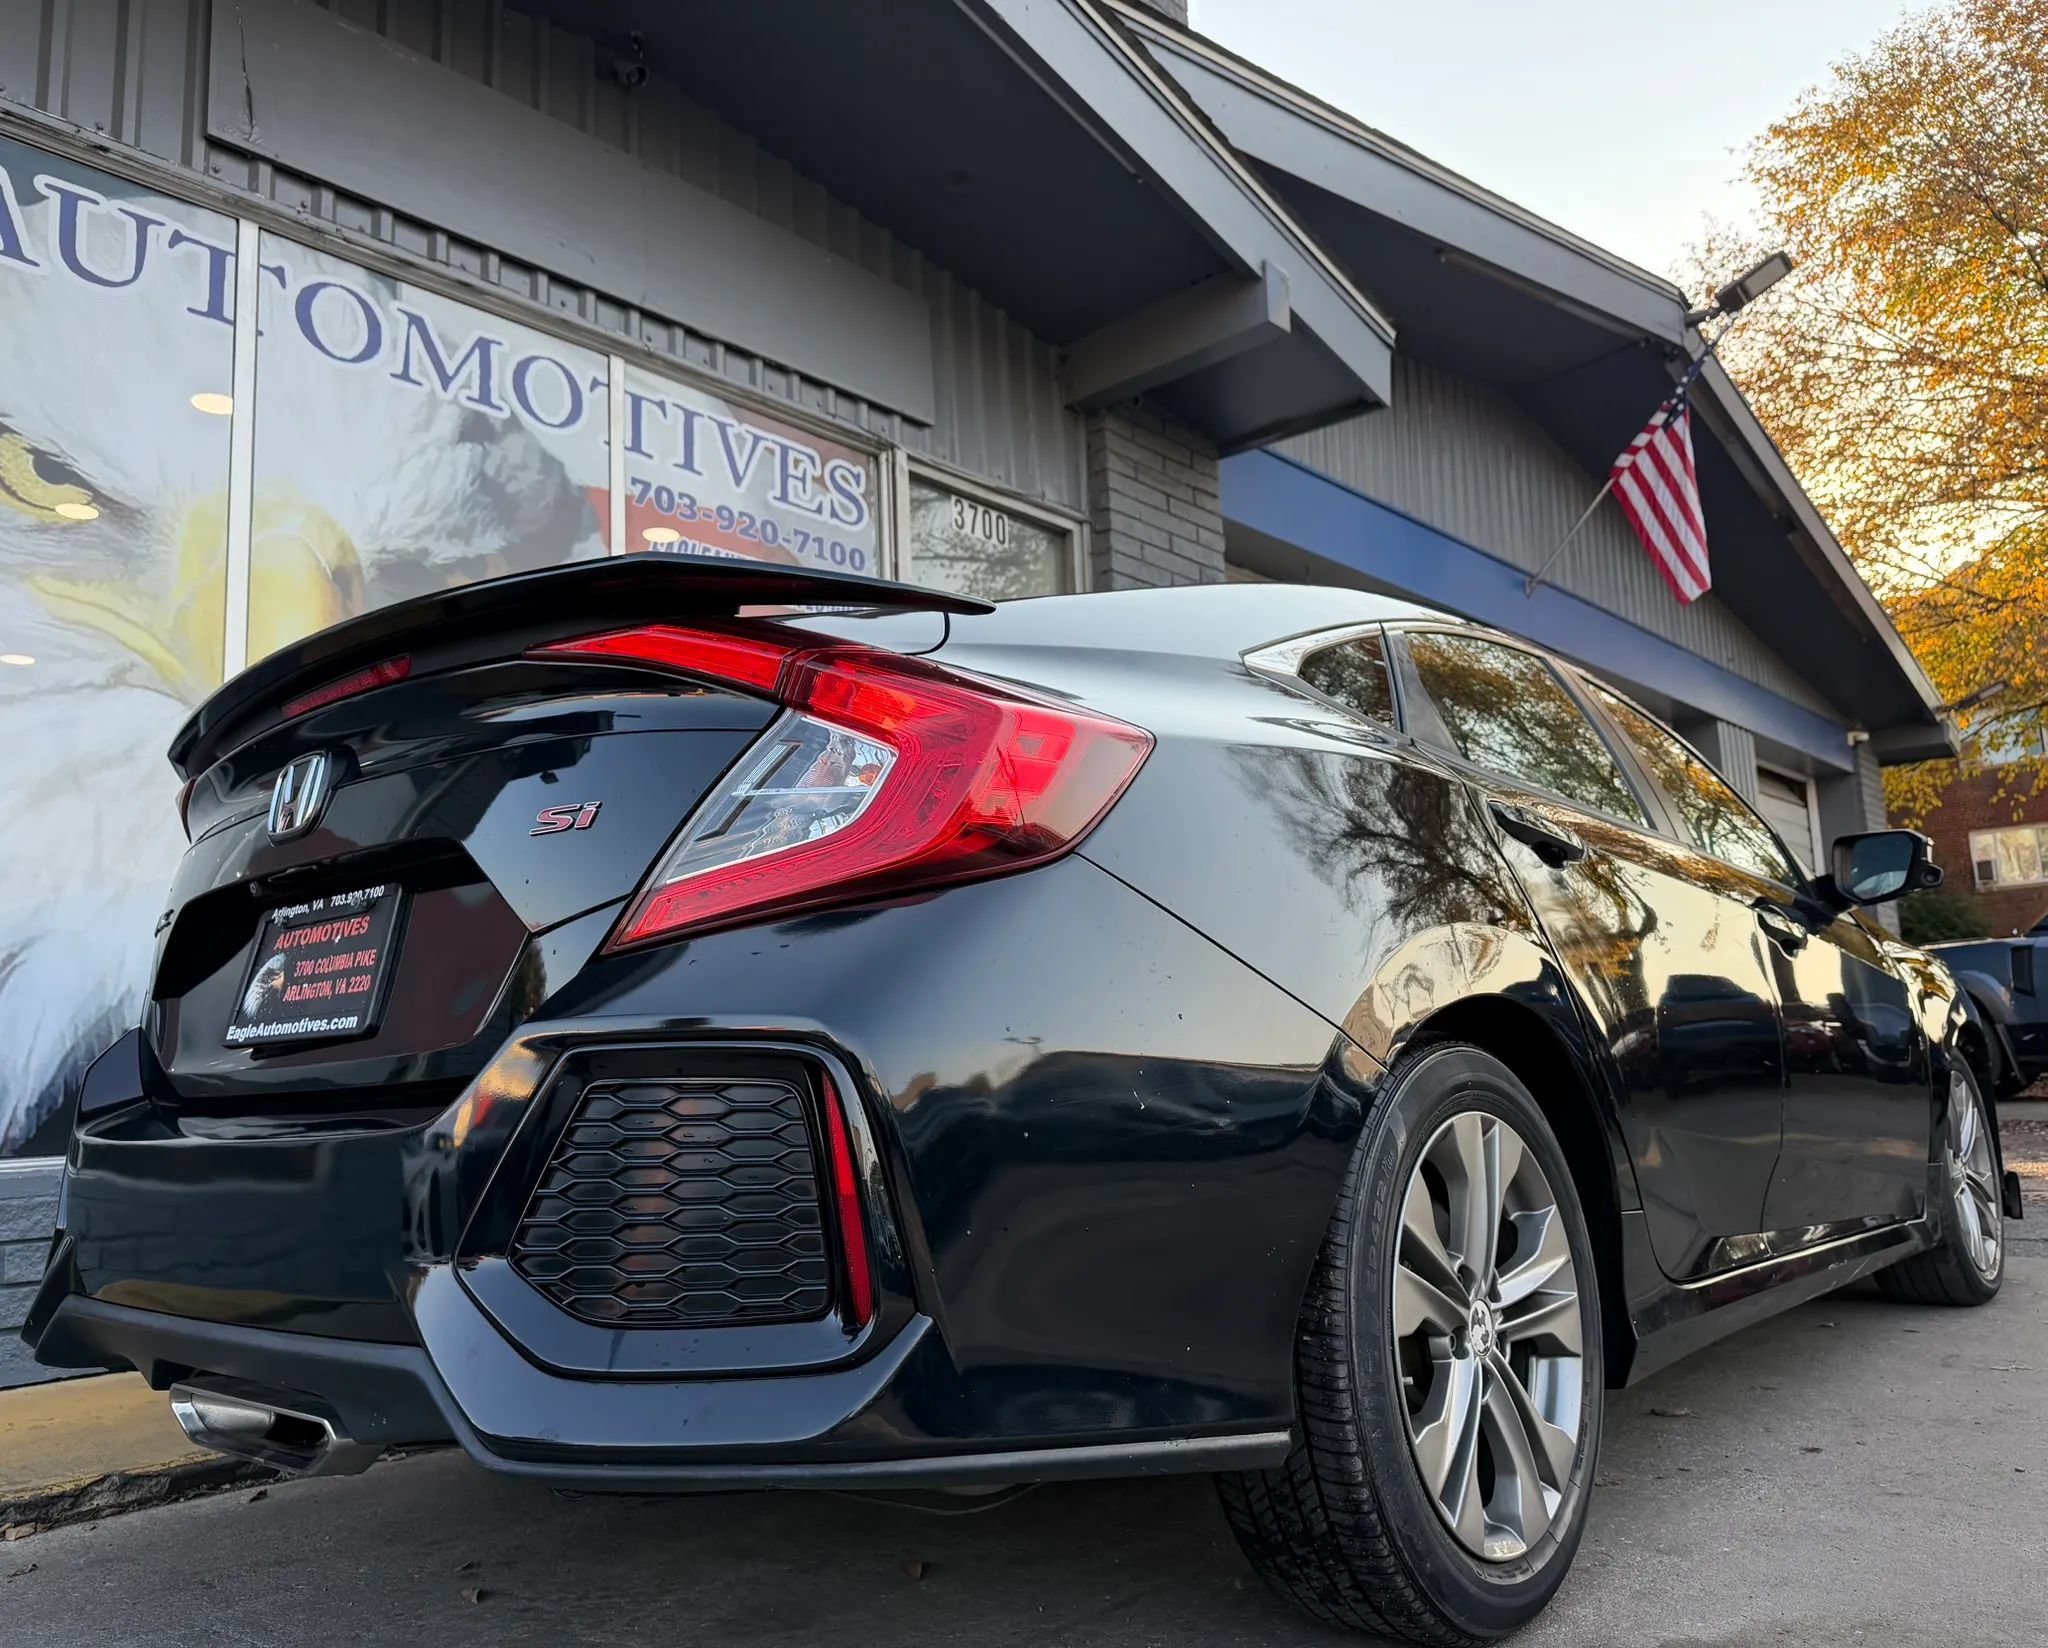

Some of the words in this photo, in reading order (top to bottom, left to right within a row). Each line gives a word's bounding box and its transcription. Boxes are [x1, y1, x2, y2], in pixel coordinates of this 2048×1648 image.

[630, 477, 866, 571] 703-920-7100
[954, 498, 1006, 545] 3700
[529, 801, 602, 835] Si
[271, 904, 310, 919] Arlington,
[312, 898, 324, 911] VA
[330, 885, 385, 907] 703.920.7100
[273, 915, 370, 950] AUTOMOTIVES
[293, 960, 314, 977] 3700
[315, 953, 353, 975] COLUMBIA
[354, 949, 377, 967] PIKE
[282, 980, 332, 1001] ARLINGTON,
[335, 979, 347, 995] VA
[226, 1015, 359, 1042] EagleAutomotives.com
